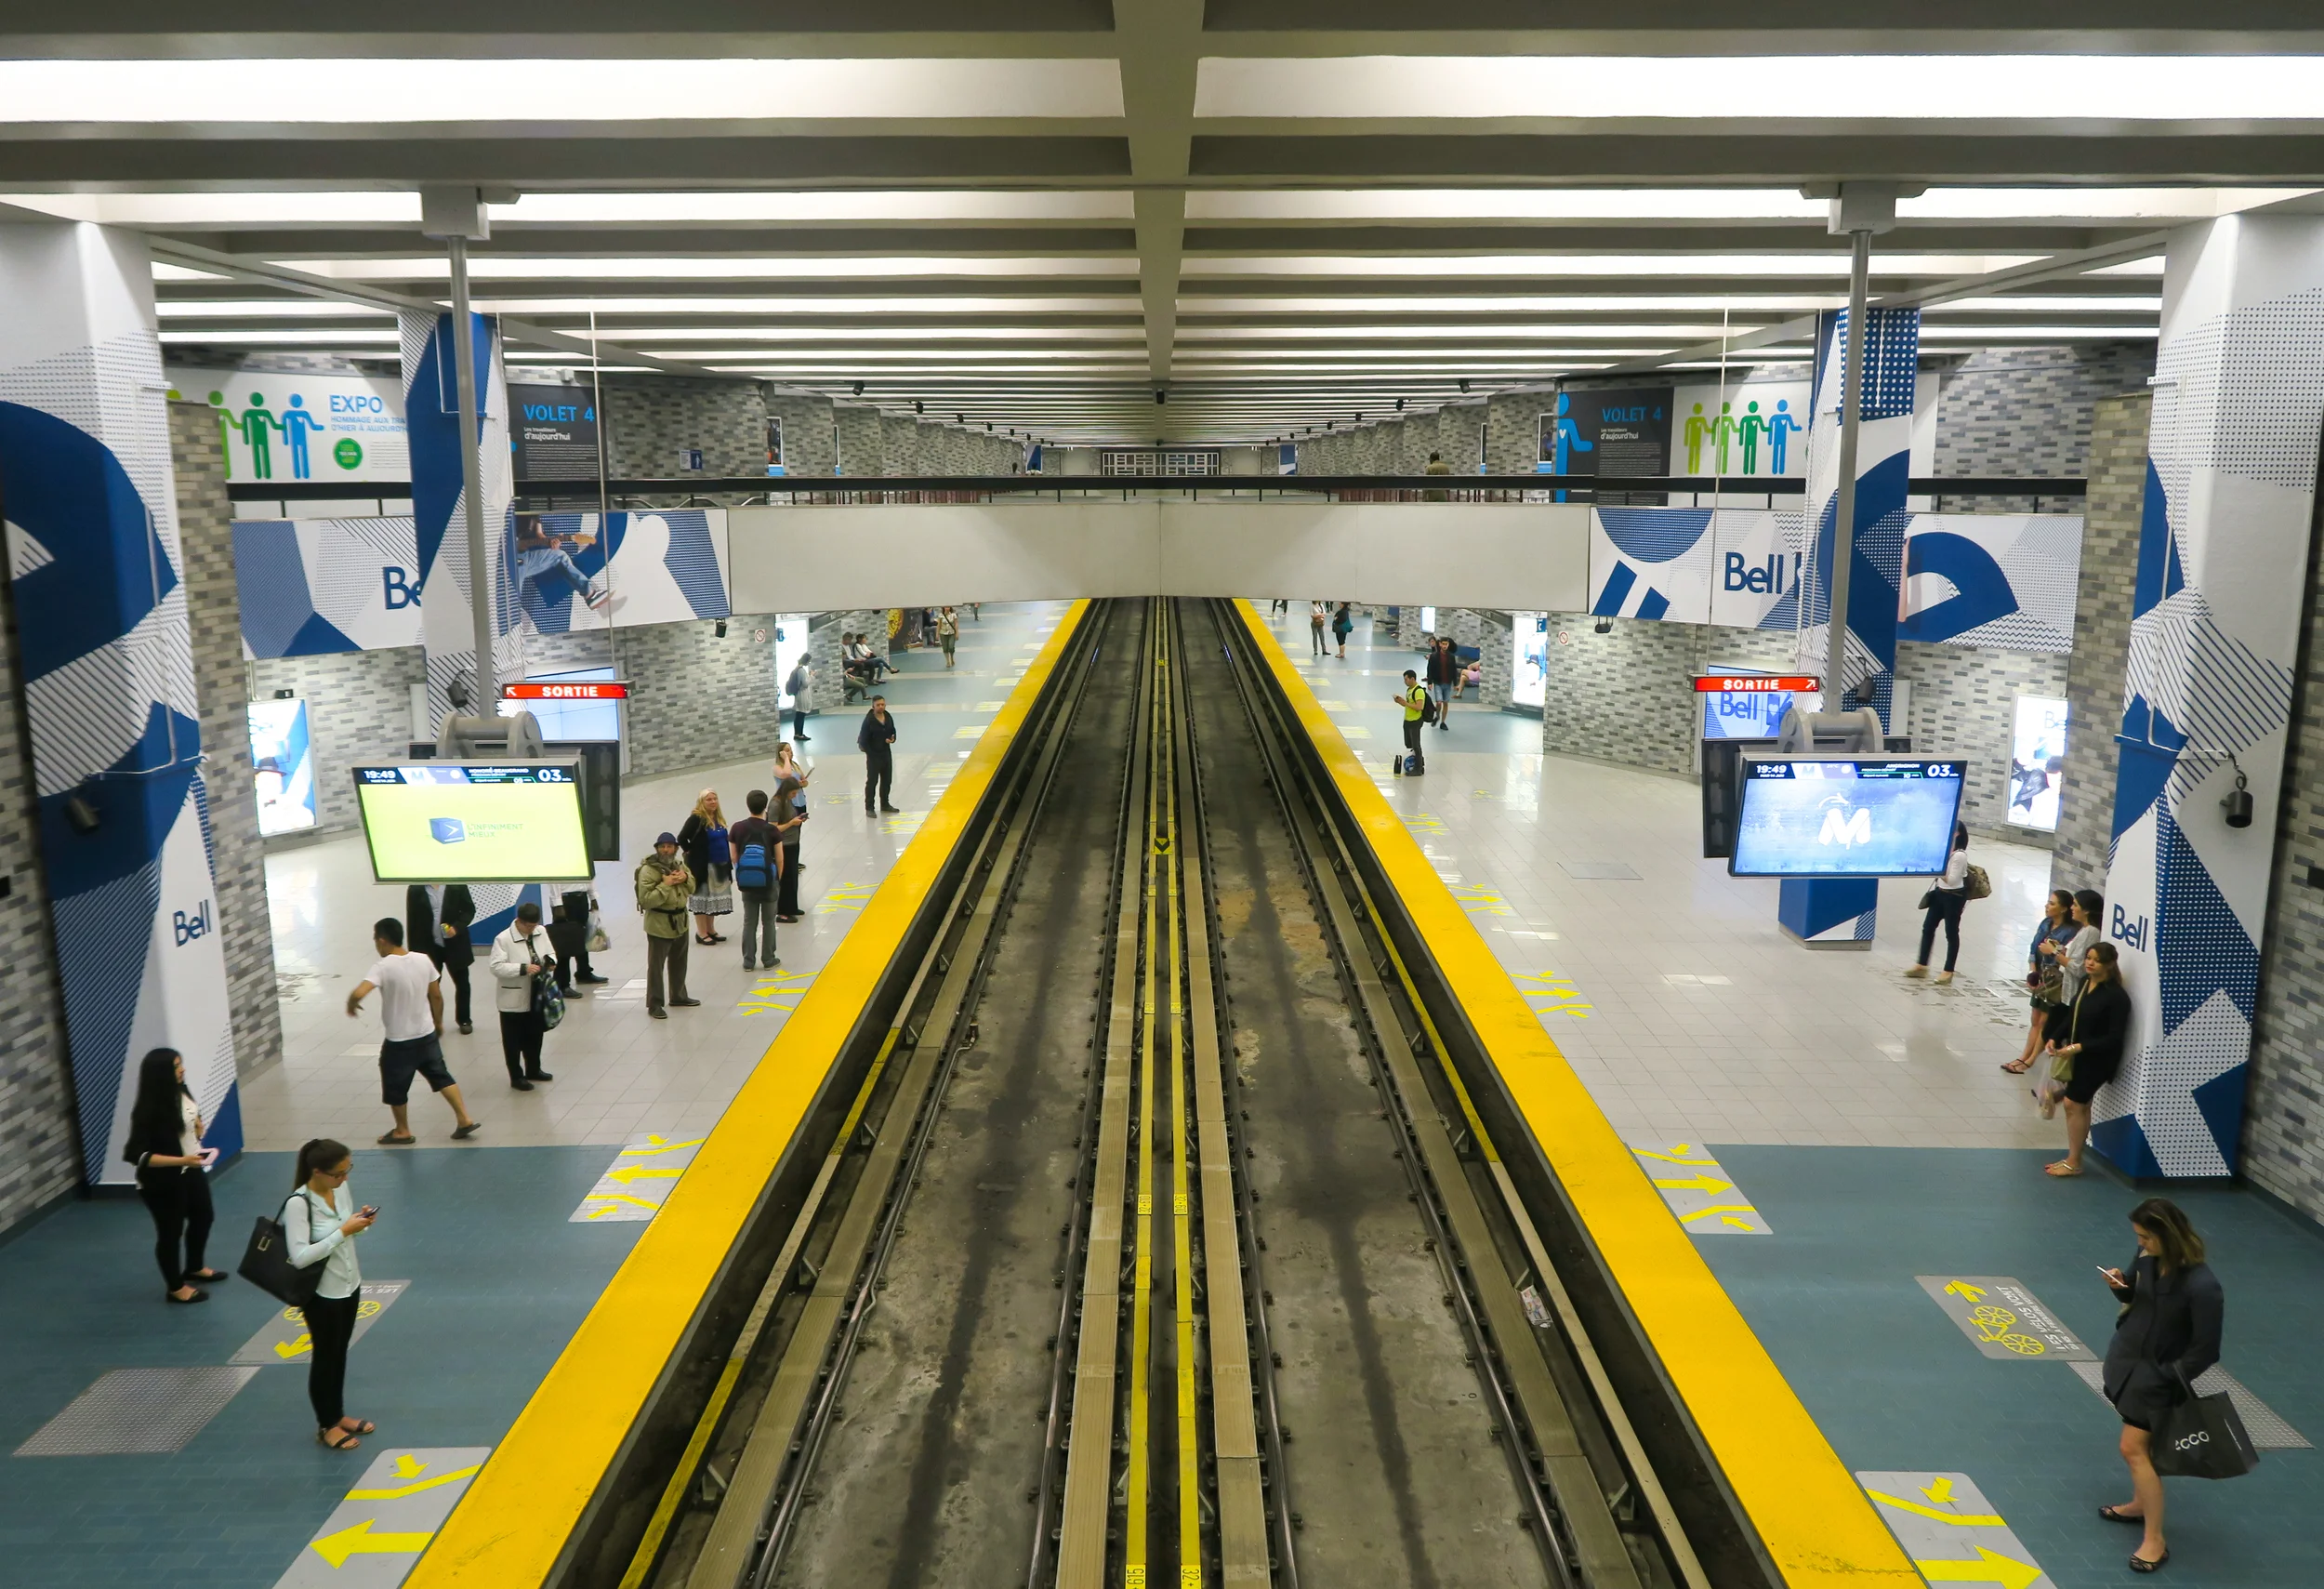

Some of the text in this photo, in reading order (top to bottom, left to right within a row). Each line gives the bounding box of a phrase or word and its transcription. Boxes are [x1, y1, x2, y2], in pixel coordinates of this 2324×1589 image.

[329, 394, 383, 413] EXPO
[331, 416, 371, 424] HOMMAGE
[522, 404, 595, 422] VOLET 4
[1602, 406, 1662, 422] VOLET 4
[524, 432, 571, 442] d'aujourd'hui
[1601, 432, 1639, 441] d'aujourd'hui
[1724, 551, 1784, 594] Bell
[383, 566, 422, 610] Be
[542, 685, 598, 697] SORTIE
[1723, 679, 1779, 690] SORTIE
[1720, 692, 1758, 720] Bell
[2044, 710, 2068, 731] Be
[363, 770, 396, 779] 19:49
[538, 769, 561, 782] 03
[1757, 764, 1787, 774] 19:49
[1927, 764, 1950, 777] 03
[173, 899, 211, 947] Bell
[2111, 903, 2148, 952] Bell
[1995, 1286, 2024, 1306] VONT
